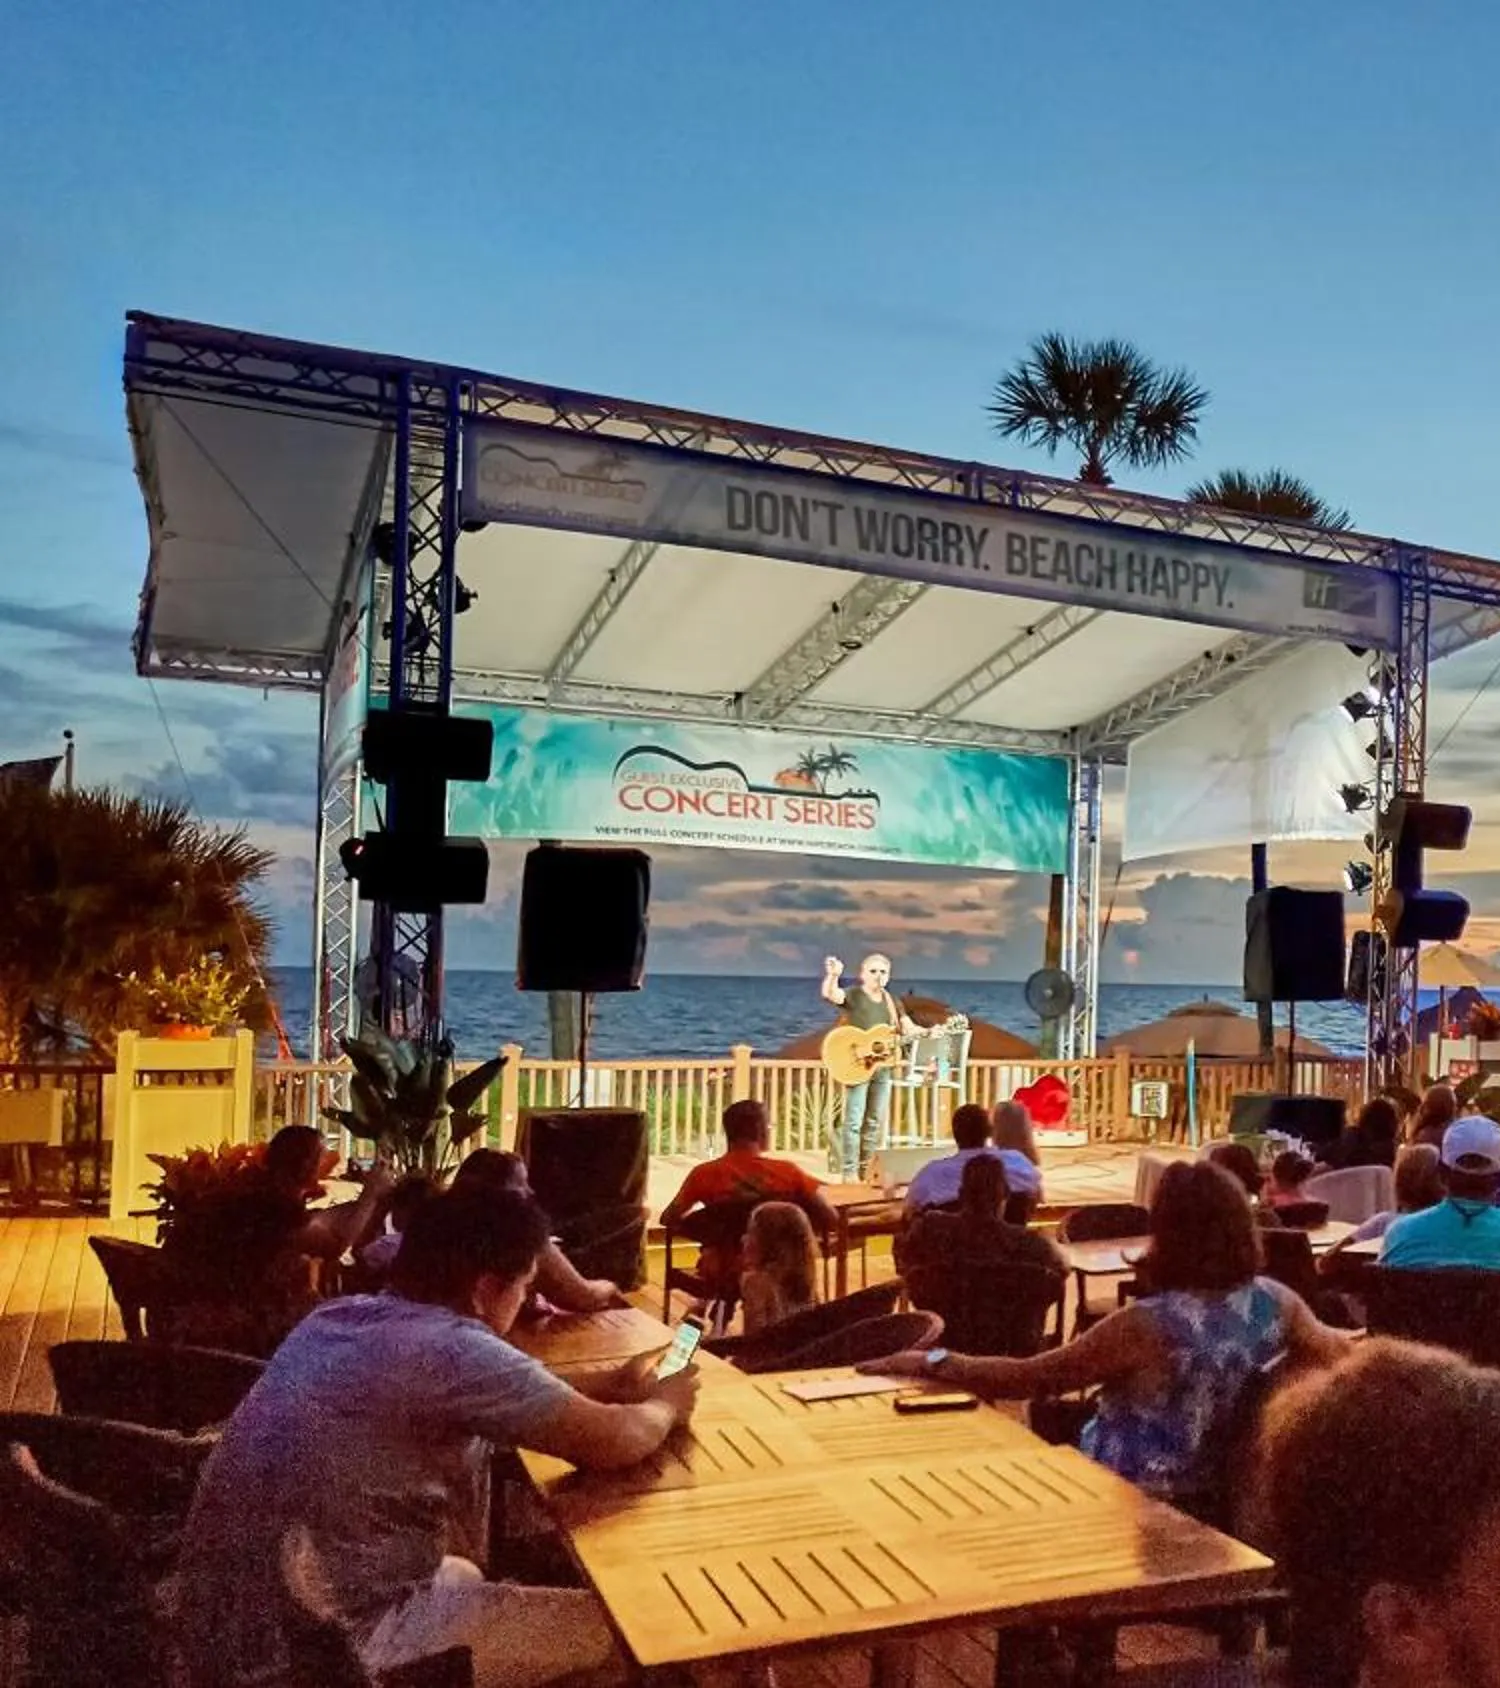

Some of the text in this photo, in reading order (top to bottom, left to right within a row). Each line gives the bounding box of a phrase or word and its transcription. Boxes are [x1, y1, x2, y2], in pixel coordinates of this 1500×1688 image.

[725, 485, 844, 546] DON'T
[855, 508, 990, 571] WORRY.
[1005, 530, 1118, 591] BEACH
[1126, 551, 1234, 609] HAPPY.
[670, 773, 740, 790] EXCLUSIVE
[618, 783, 876, 830] CONCERT SERIES
[623, 827, 642, 836] THE
[670, 829, 714, 840] CONCERT
[717, 833, 763, 844] SCHEDULE
